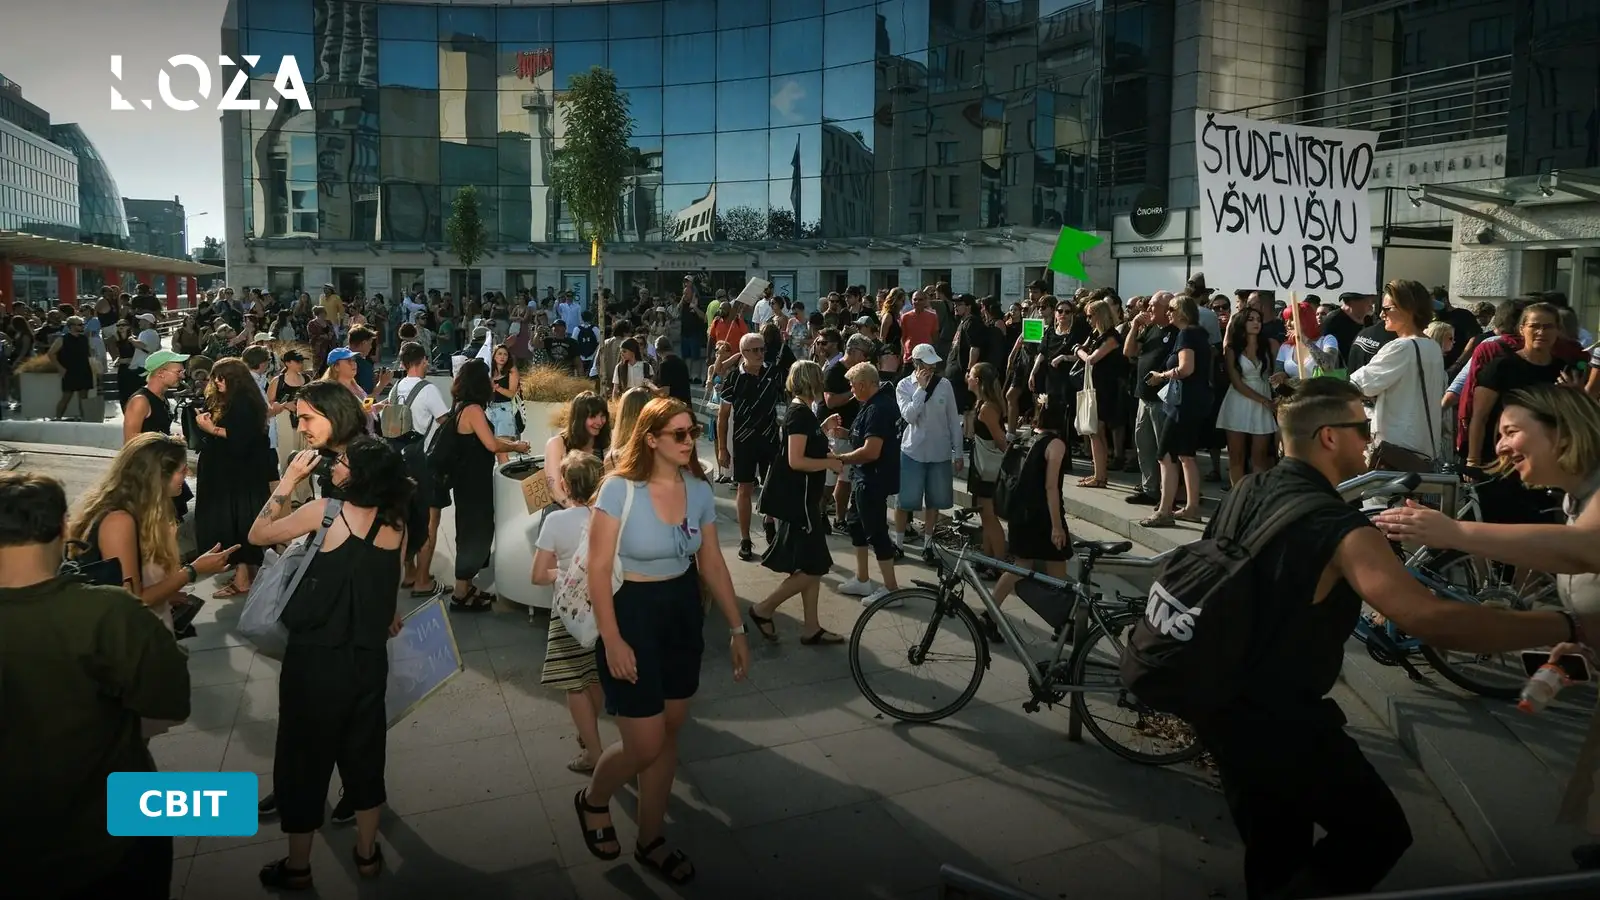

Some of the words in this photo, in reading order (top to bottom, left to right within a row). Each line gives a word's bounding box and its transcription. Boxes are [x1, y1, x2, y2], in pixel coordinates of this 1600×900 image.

[1202, 113, 1374, 191] ŠTUDENTSTVO
[1409, 153, 1504, 176] DIVADLO
[1207, 180, 1285, 235] VŠMU
[1294, 190, 1357, 244] VŠVU
[1256, 242, 1295, 289] AU
[1302, 244, 1344, 290] BB
